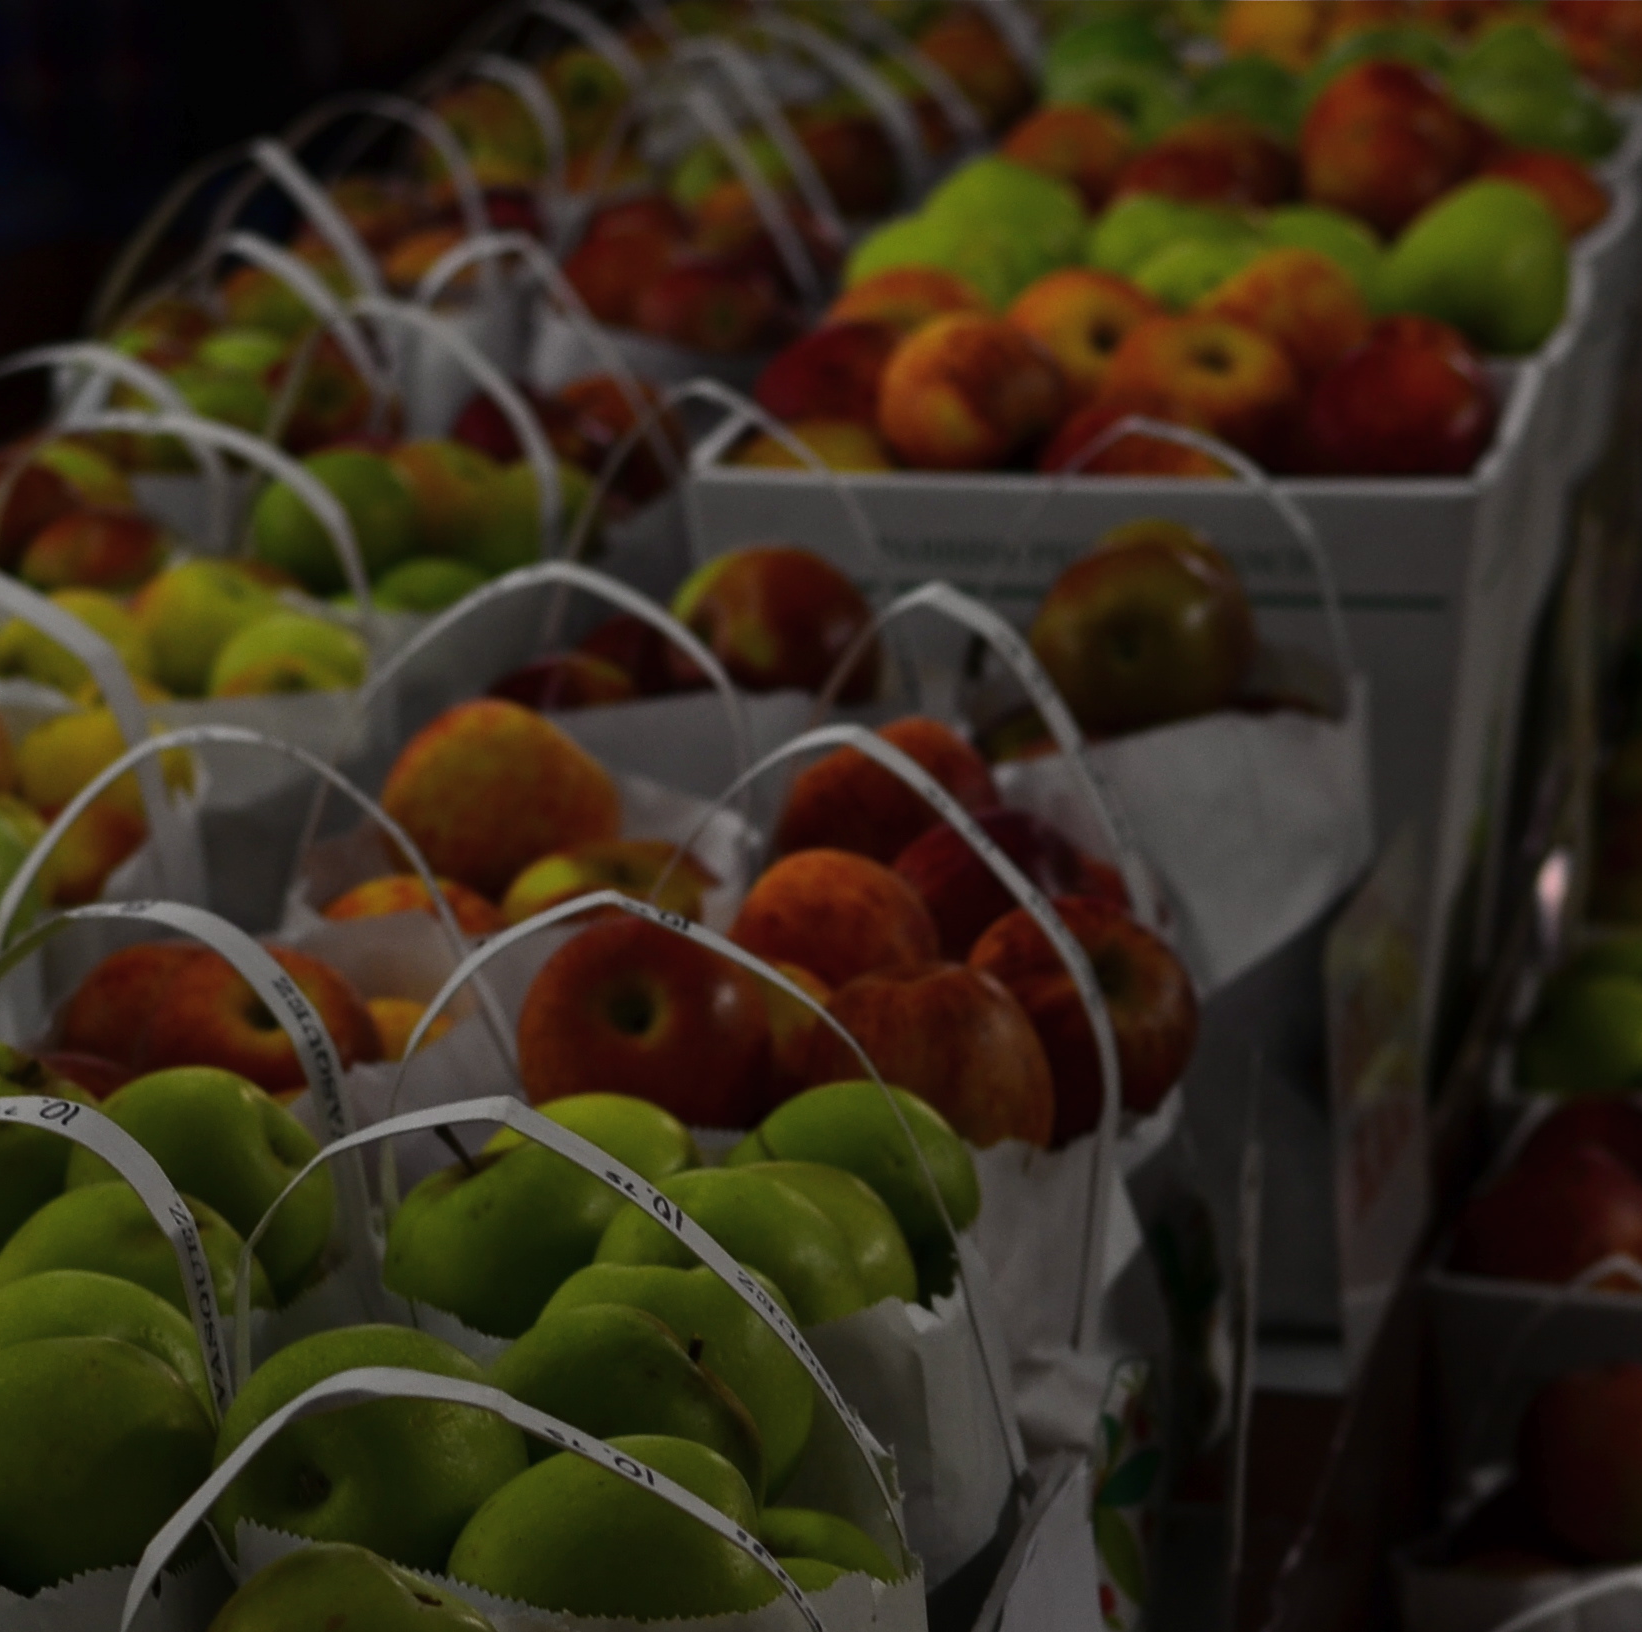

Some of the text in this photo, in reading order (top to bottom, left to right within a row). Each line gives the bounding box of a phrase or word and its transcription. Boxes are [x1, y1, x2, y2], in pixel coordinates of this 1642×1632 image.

[606, 1170, 683, 1232] 10.75
[168, 1201, 225, 1404] VASQUEZ
[737, 1270, 861, 1439] VASQUEZ
